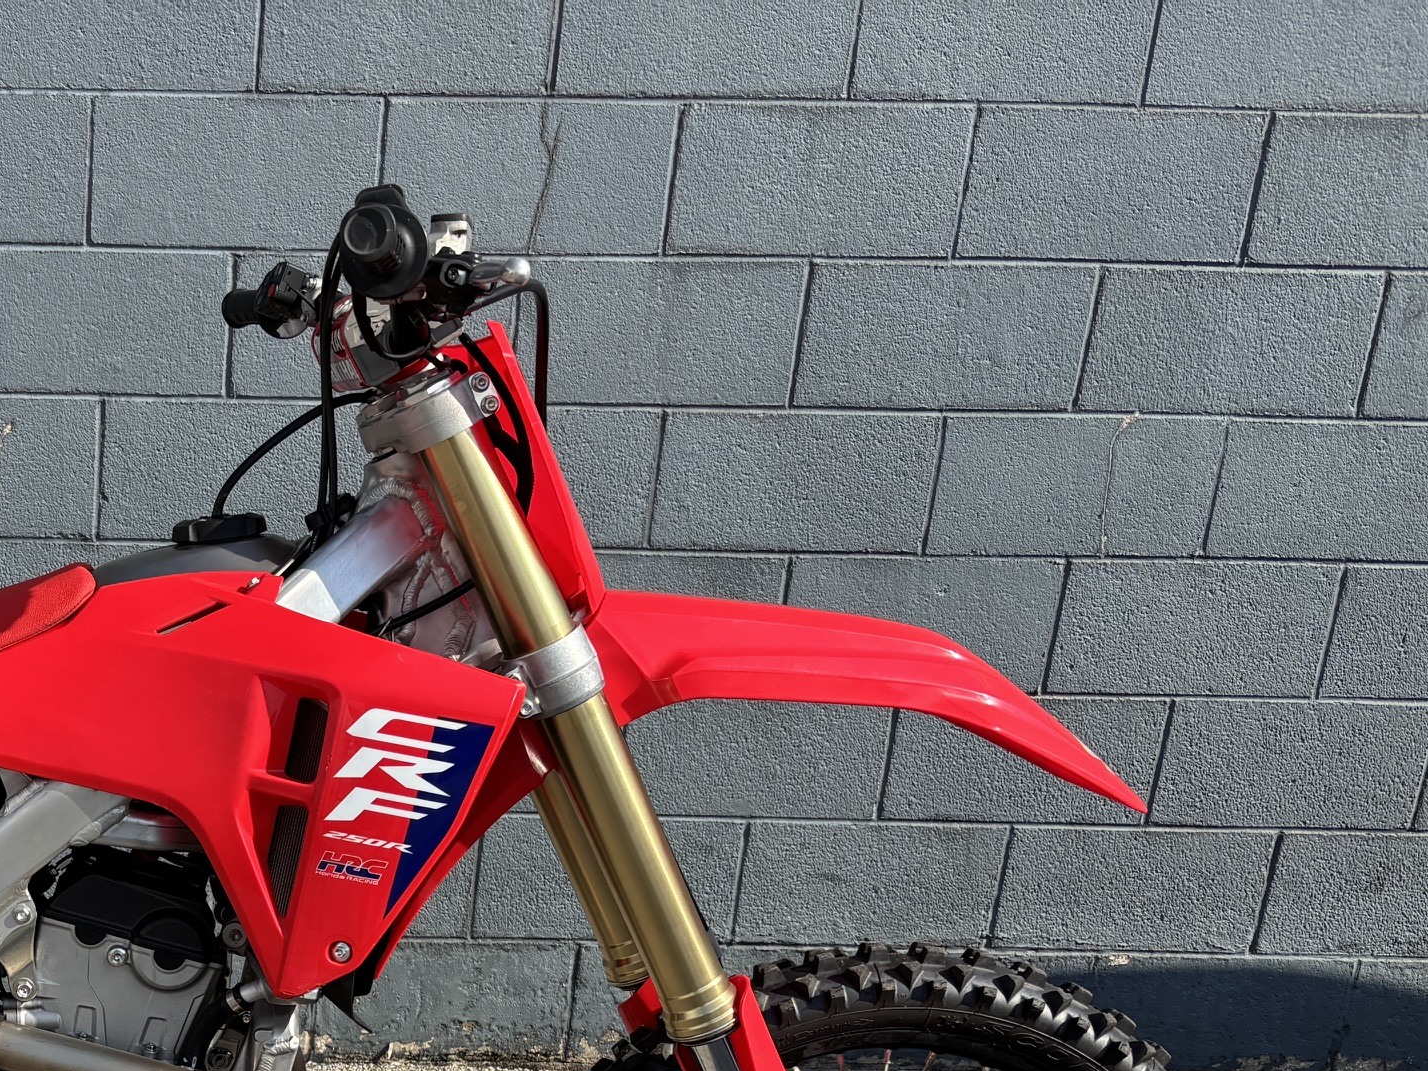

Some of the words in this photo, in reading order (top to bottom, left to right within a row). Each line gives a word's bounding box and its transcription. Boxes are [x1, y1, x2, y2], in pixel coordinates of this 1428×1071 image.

[323, 708, 468, 821] CRF
[322, 830, 414, 854] 250R
[315, 870, 346, 880] Honda
[346, 875, 379, 886] RACING
[316, 851, 389, 881] HRC
